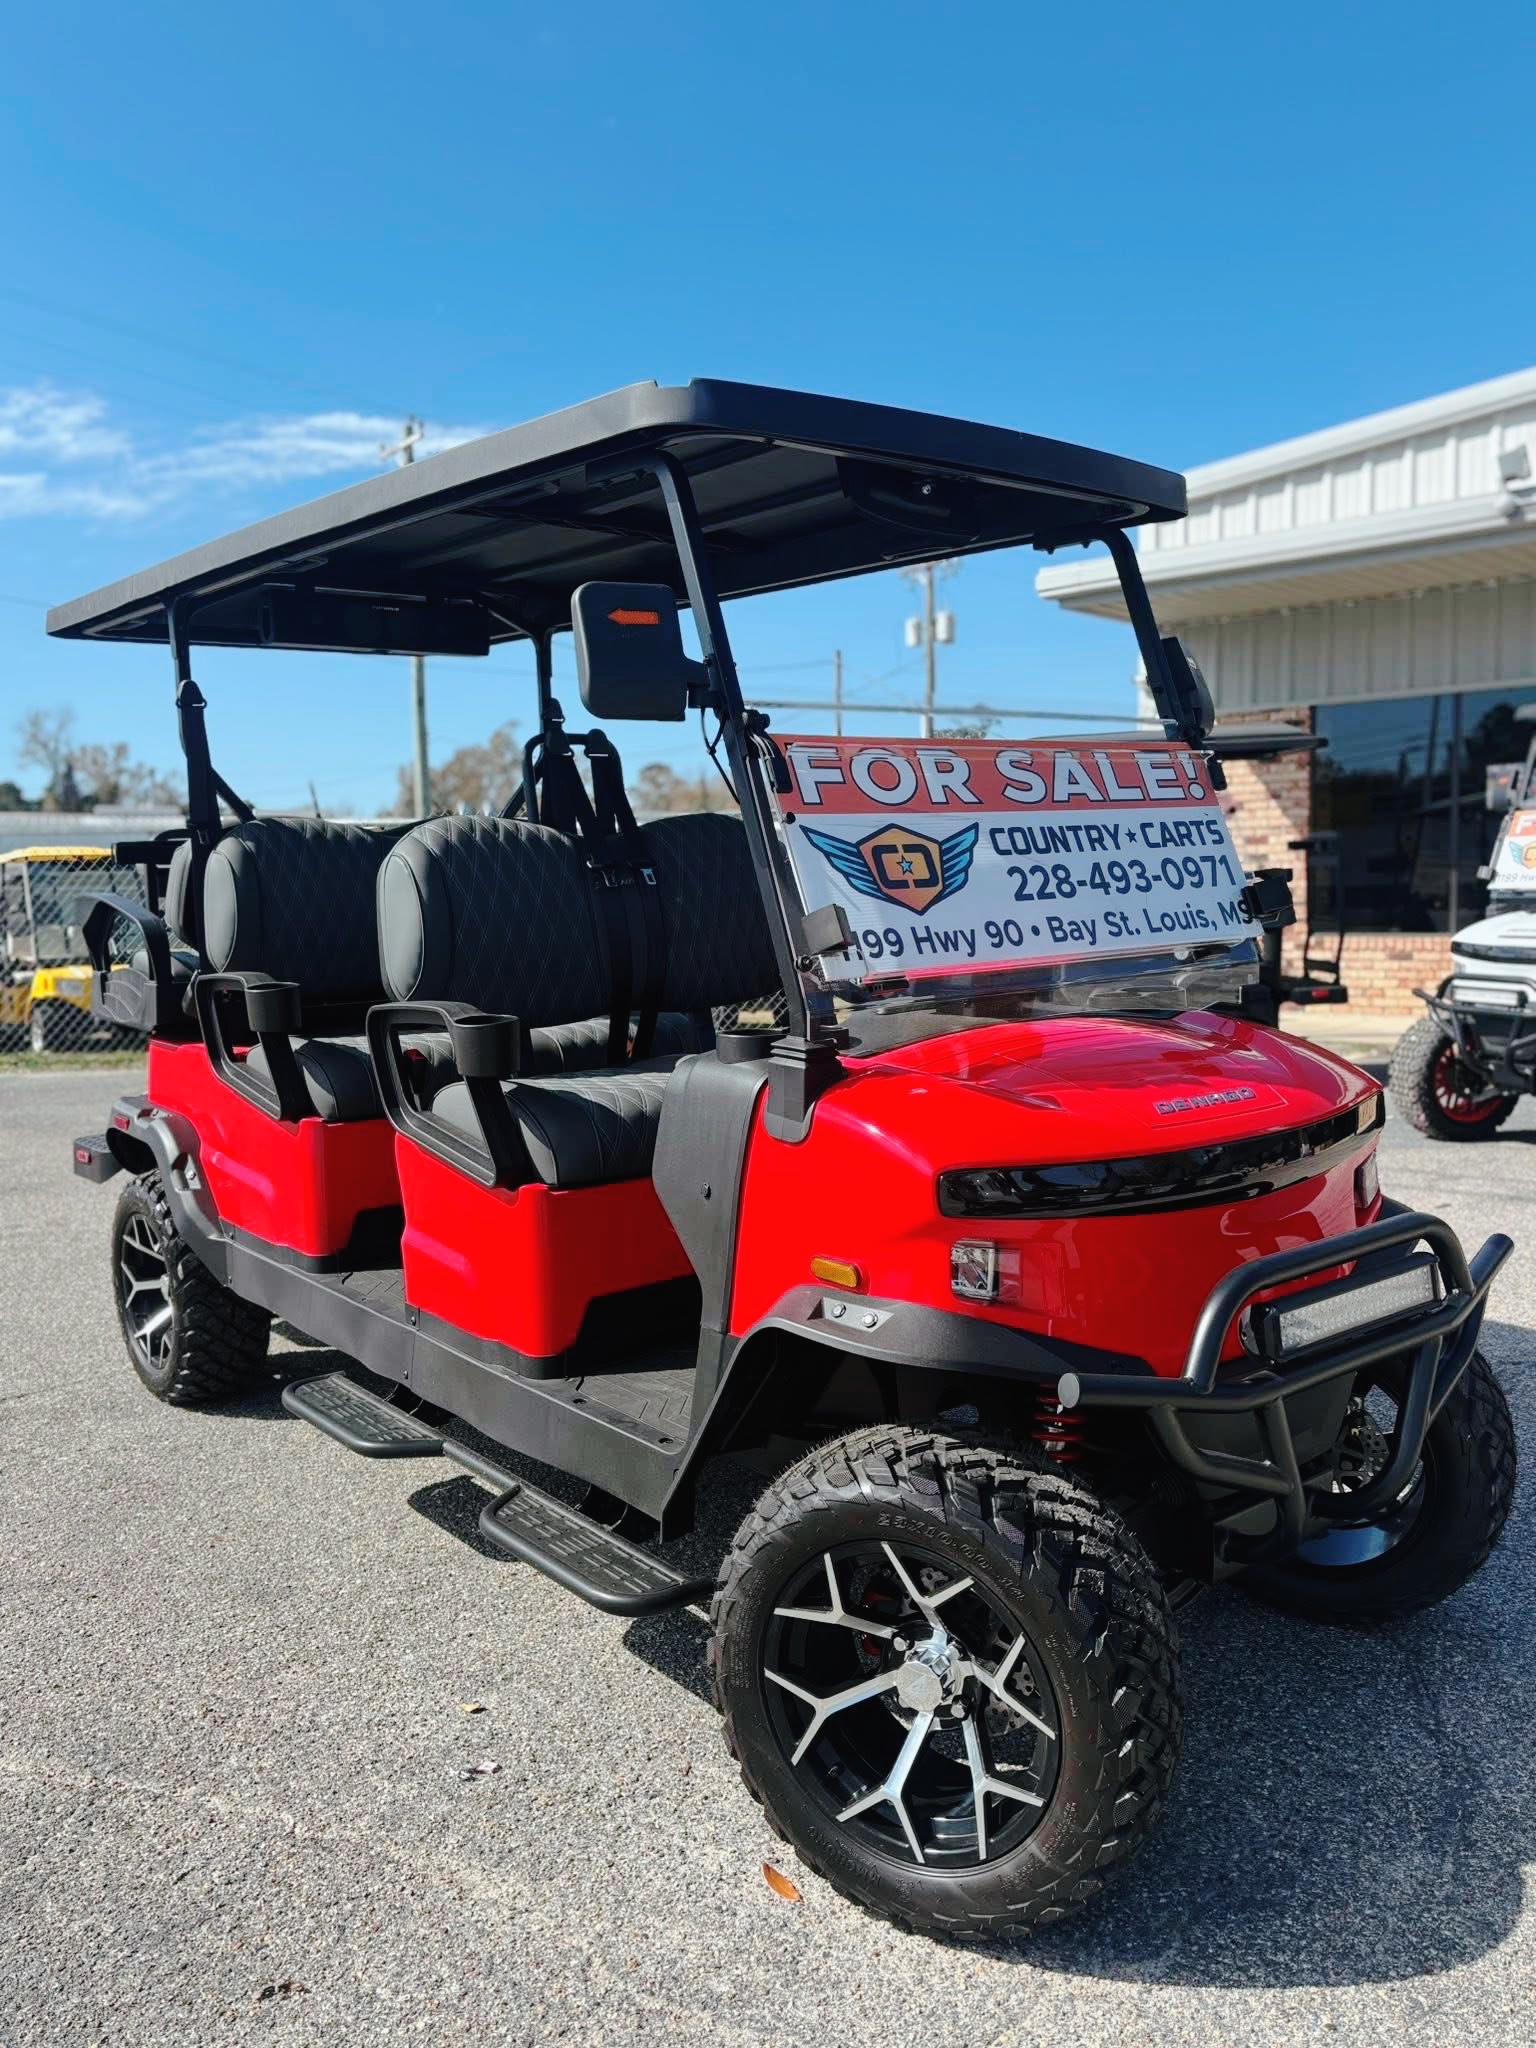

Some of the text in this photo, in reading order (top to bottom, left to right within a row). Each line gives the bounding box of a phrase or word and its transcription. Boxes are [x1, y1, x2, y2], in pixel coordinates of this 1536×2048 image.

[785, 743, 1206, 807] FOR SALE!
[989, 819, 1225, 856] COUNTRY CARTS
[1006, 854, 1237, 901] 228-493-0971
[910, 925, 976, 958] Hwy
[983, 919, 1024, 949] 90
[1046, 916, 1097, 946] Bay
[1103, 911, 1141, 938] St.
[1142, 902, 1218, 933] Louis,
[1153, 1087, 1256, 1115] DENAGO
